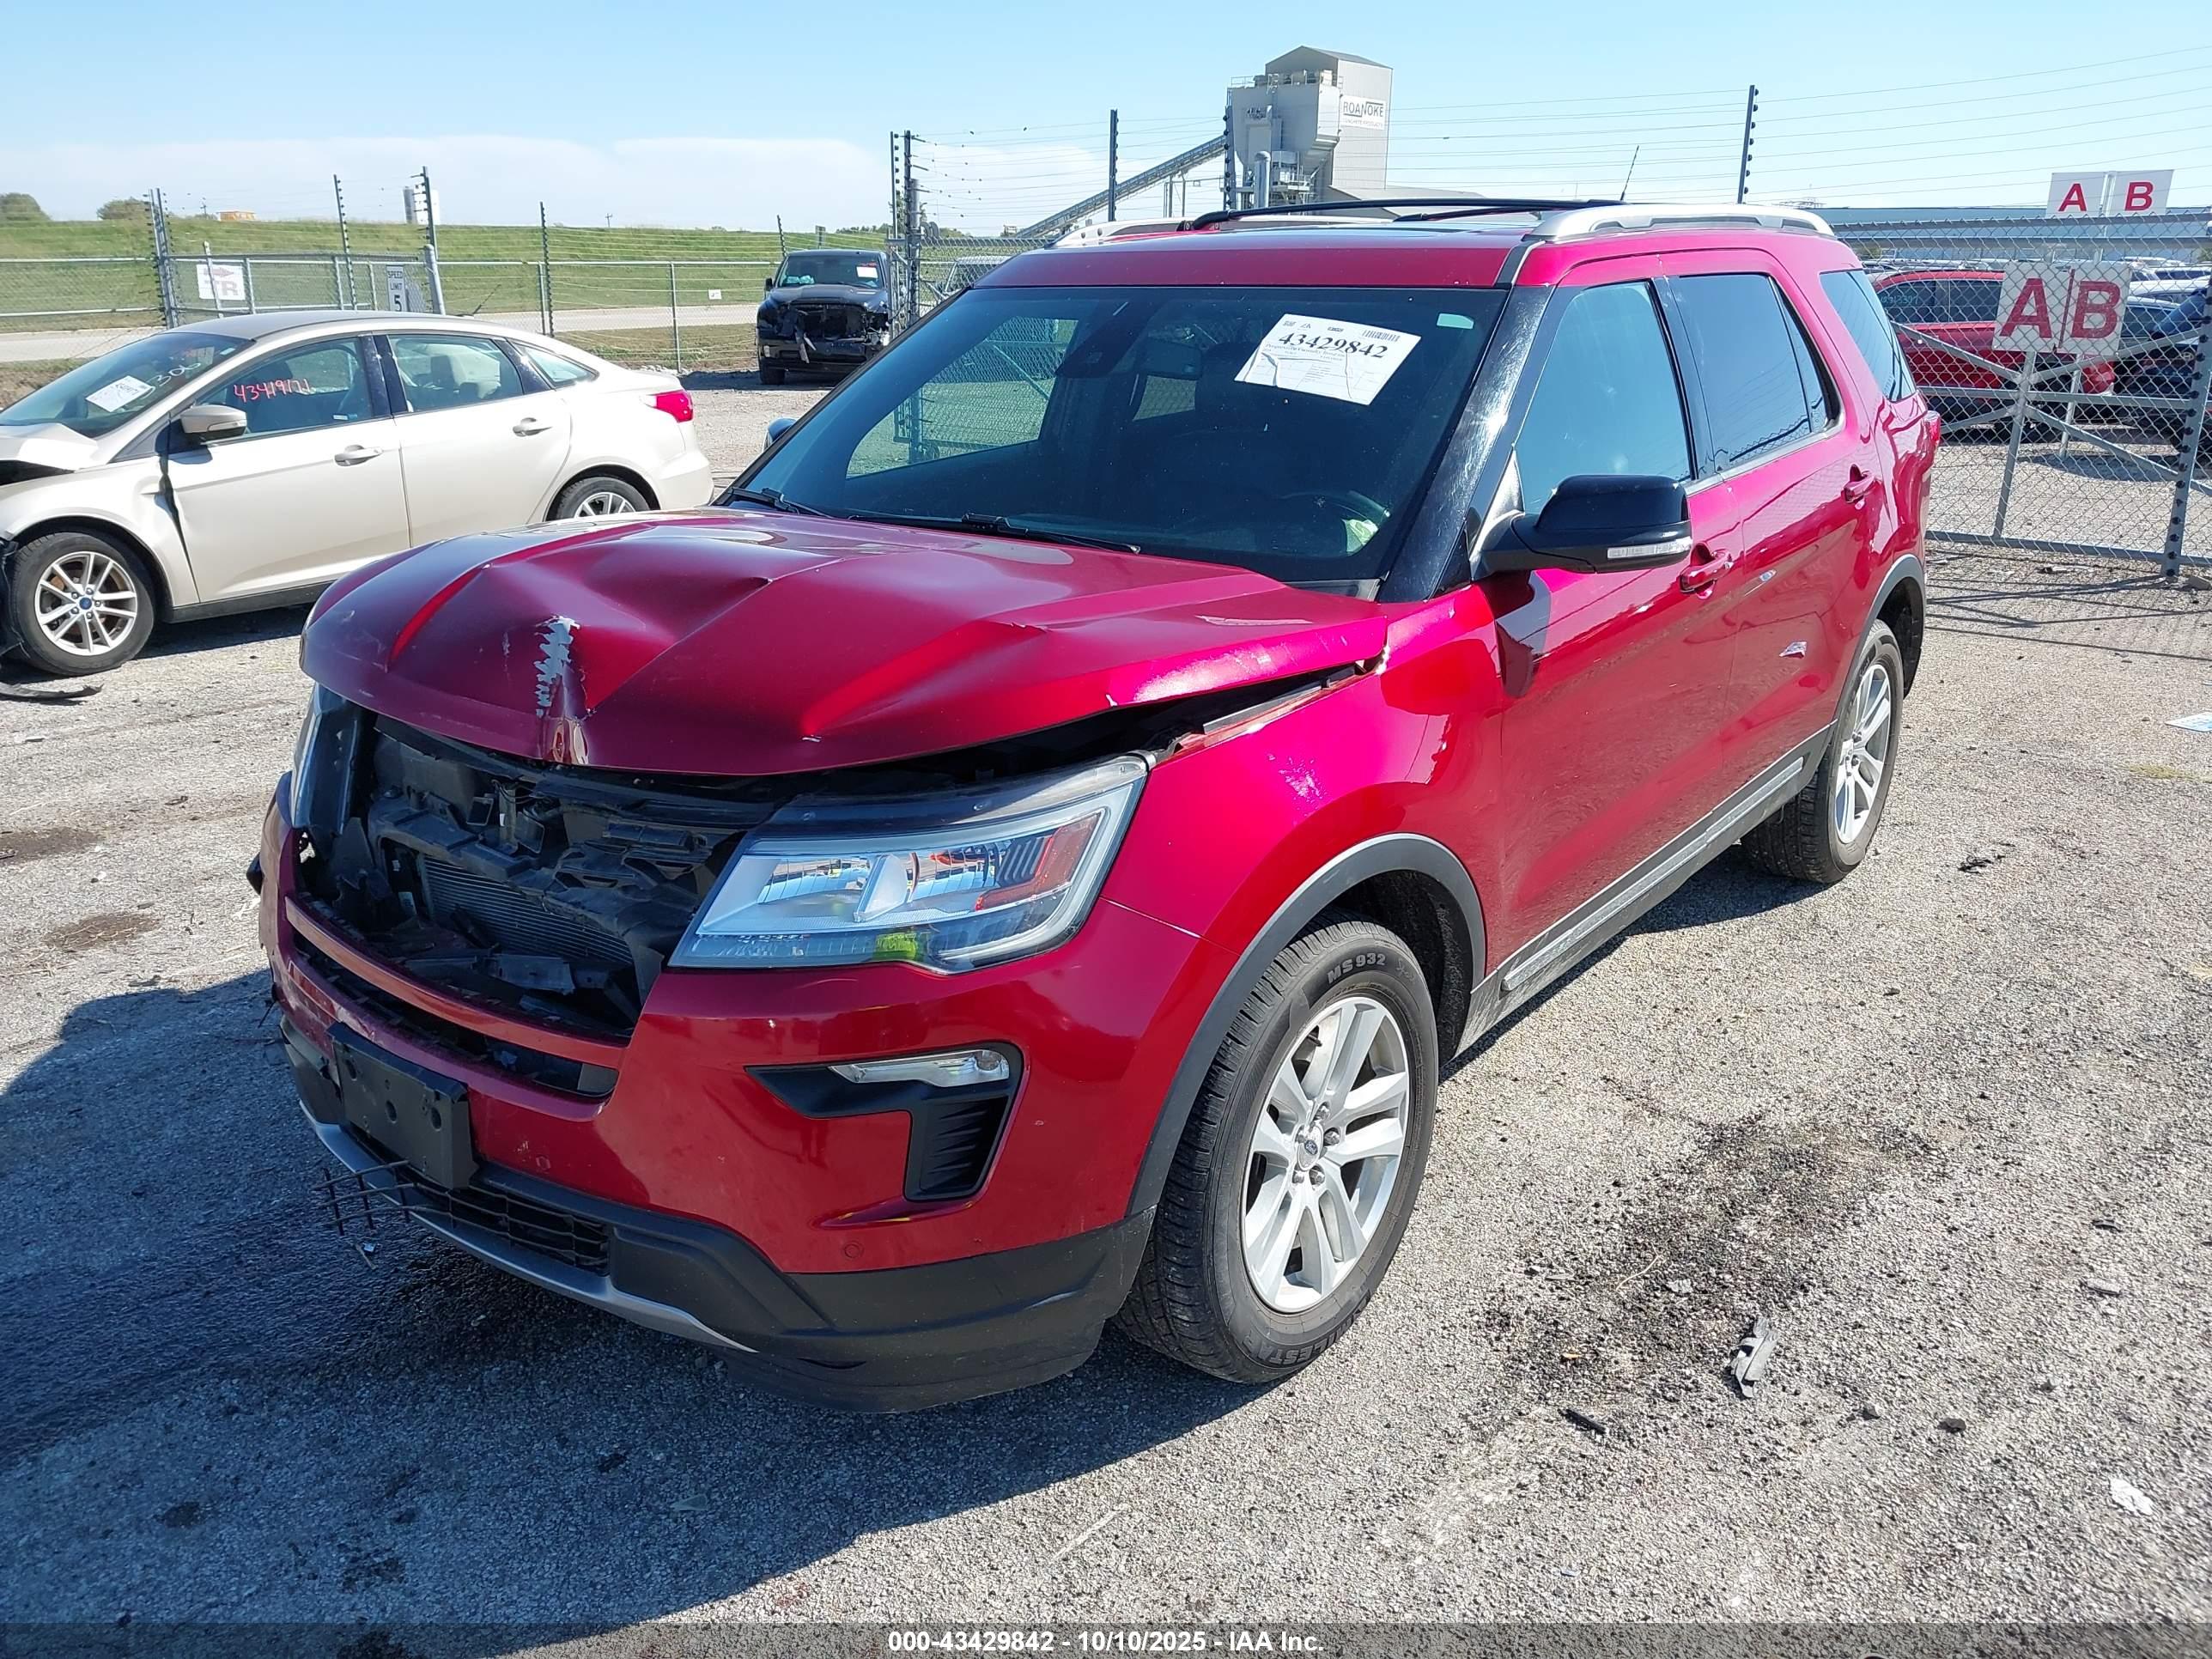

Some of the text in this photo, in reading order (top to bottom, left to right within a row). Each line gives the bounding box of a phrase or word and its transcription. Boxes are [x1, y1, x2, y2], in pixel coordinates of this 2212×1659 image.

[1343, 101, 1383, 117] ROANOKE
[2058, 182, 2153, 211] A B
[393, 294, 402, 312] 5
[1999, 277, 2121, 338] A B
[1279, 332, 1389, 358] 43429842
